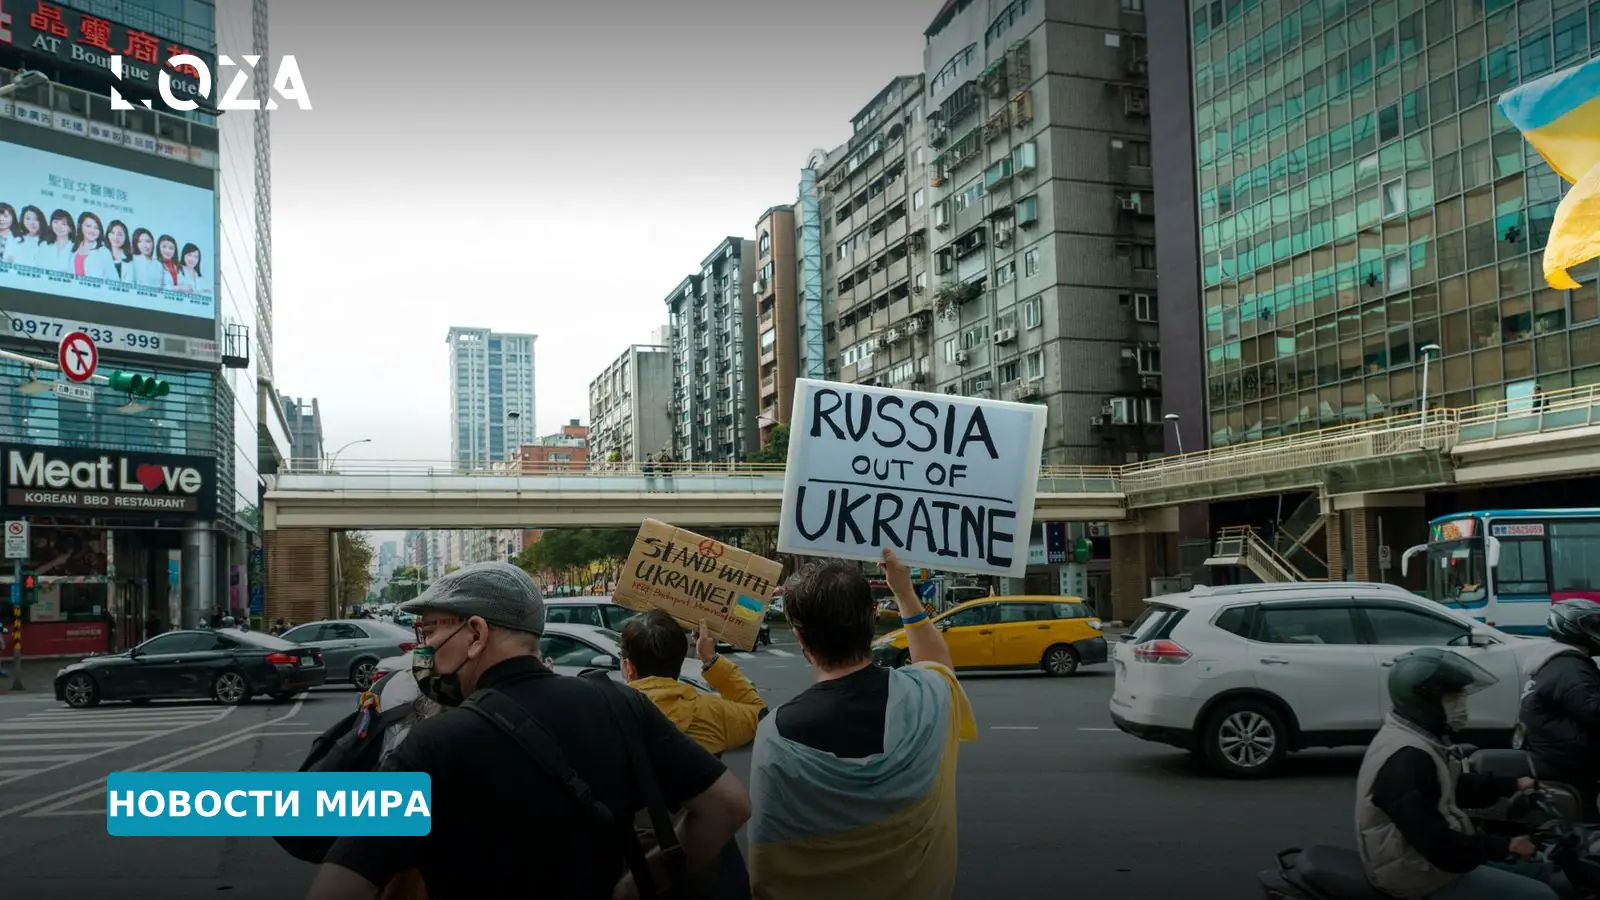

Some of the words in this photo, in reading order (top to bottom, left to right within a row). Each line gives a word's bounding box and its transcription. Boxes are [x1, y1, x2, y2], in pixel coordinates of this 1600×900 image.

[32, 33, 62, 54] AT
[70, 43, 150, 81] Boutque
[12, 318, 64, 337] 0977
[810, 388, 999, 460] RUSSIA
[9, 450, 115, 489] Meat
[852, 455, 914, 481] OUT
[926, 462, 967, 488] OF
[25, 492, 77, 504] KOREAN
[83, 495, 109, 506] BBQ
[114, 497, 185, 509] RESTAURANT
[795, 486, 1016, 567] UKRAINE
[635, 560, 735, 614] UKRAINE!
[718, 564, 771, 596] WITH
